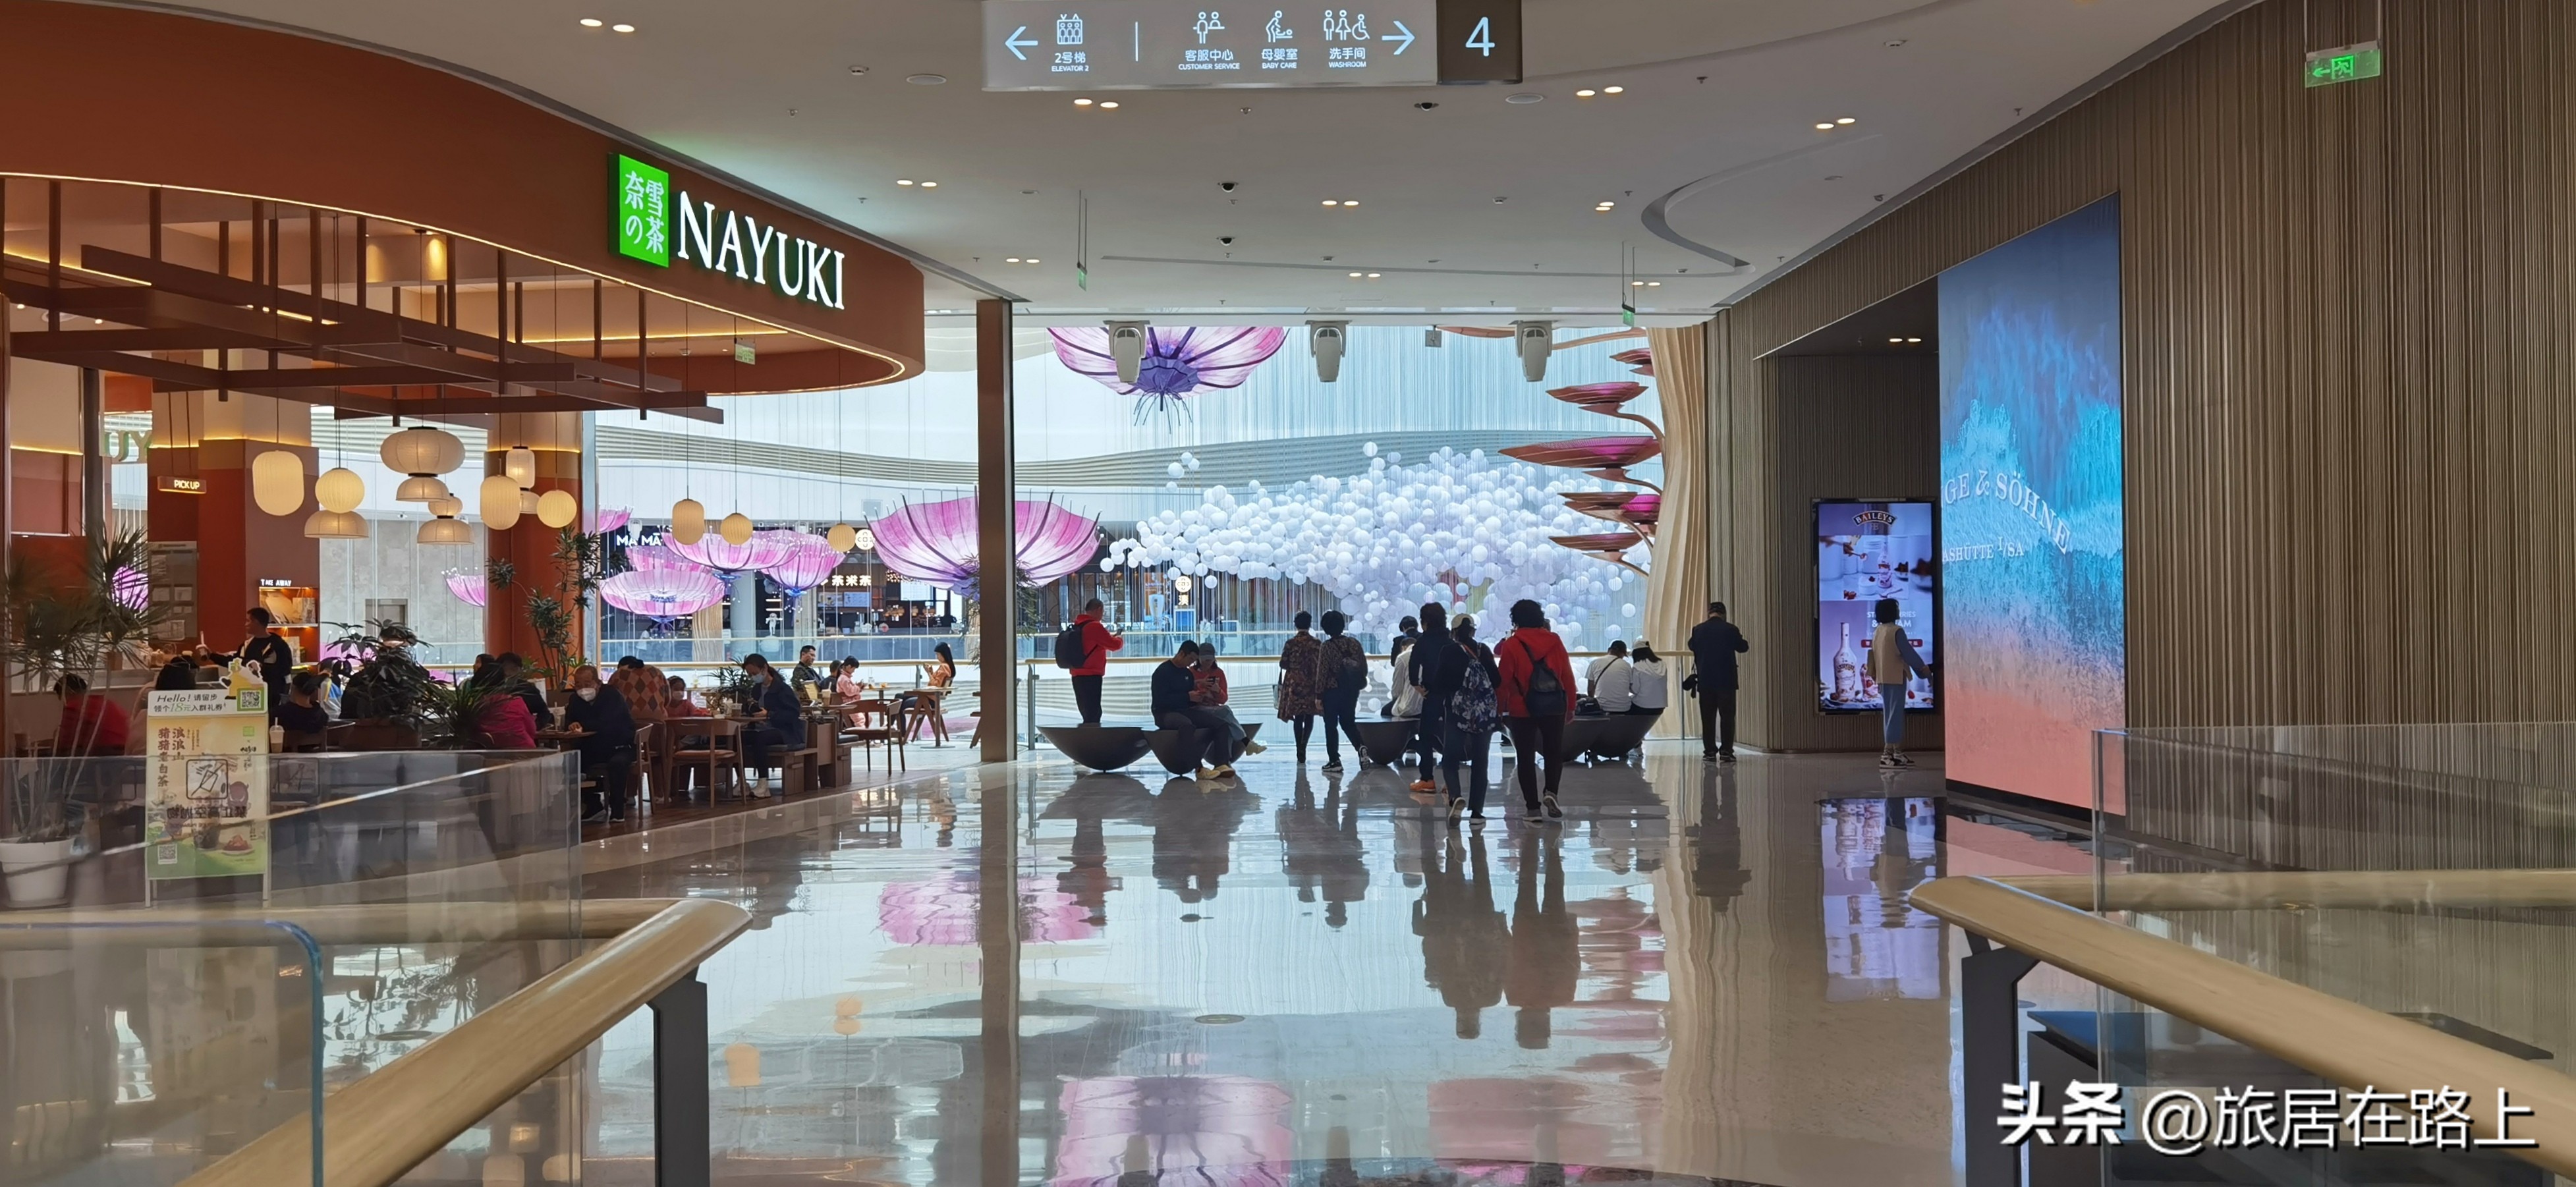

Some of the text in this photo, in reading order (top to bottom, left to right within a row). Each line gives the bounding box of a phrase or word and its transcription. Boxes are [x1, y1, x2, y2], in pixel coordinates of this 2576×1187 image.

[1465, 16, 1495, 57] 4
[1054, 51, 1086, 64] 2号梯
[1185, 49, 1233, 61] 客服中心
[1261, 48, 1298, 61] 母婴室
[1329, 47, 1366, 60] 洗手间
[677, 190, 845, 310] NAYUKI
[174, 479, 200, 490] PICK UP
[1855, 511, 1895, 524] BAILEYS
[1942, 468, 2071, 555] GE & SÖHNE
[820, 574, 872, 586] 茶米茶
[157, 694, 190, 702] Hello!
